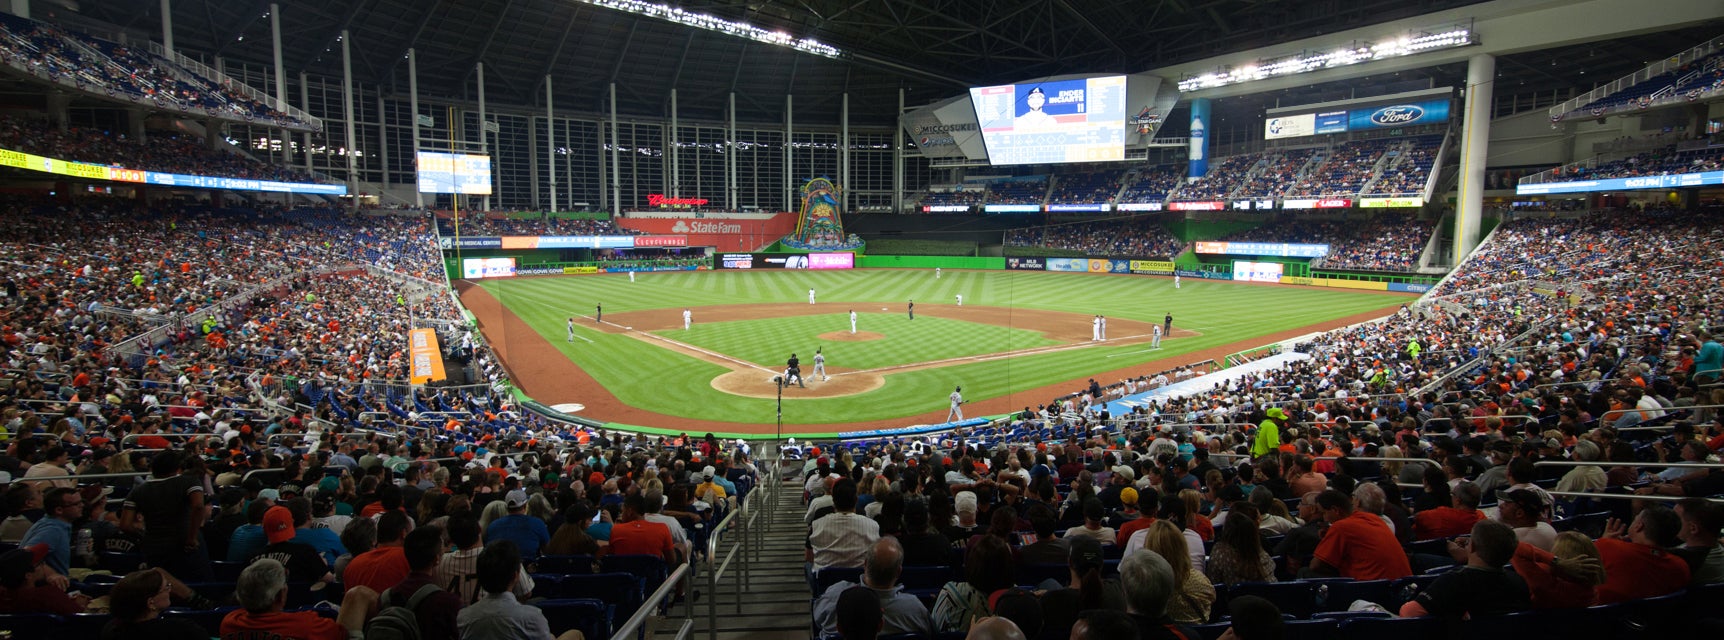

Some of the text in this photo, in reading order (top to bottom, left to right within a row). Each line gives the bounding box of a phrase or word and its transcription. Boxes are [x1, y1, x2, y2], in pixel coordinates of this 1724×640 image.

[1059, 89, 1084, 98] ENDER
[1048, 96, 1084, 105] INCIARTE
[1077, 103, 1084, 113] 11
[1379, 108, 1413, 124] Ford
[922, 123, 977, 133] MICCOSUKEE
[1625, 178, 1660, 188] 9:02 PM
[647, 194, 708, 206] Budweiser
[635, 237, 685, 246] CLEVELANDER
